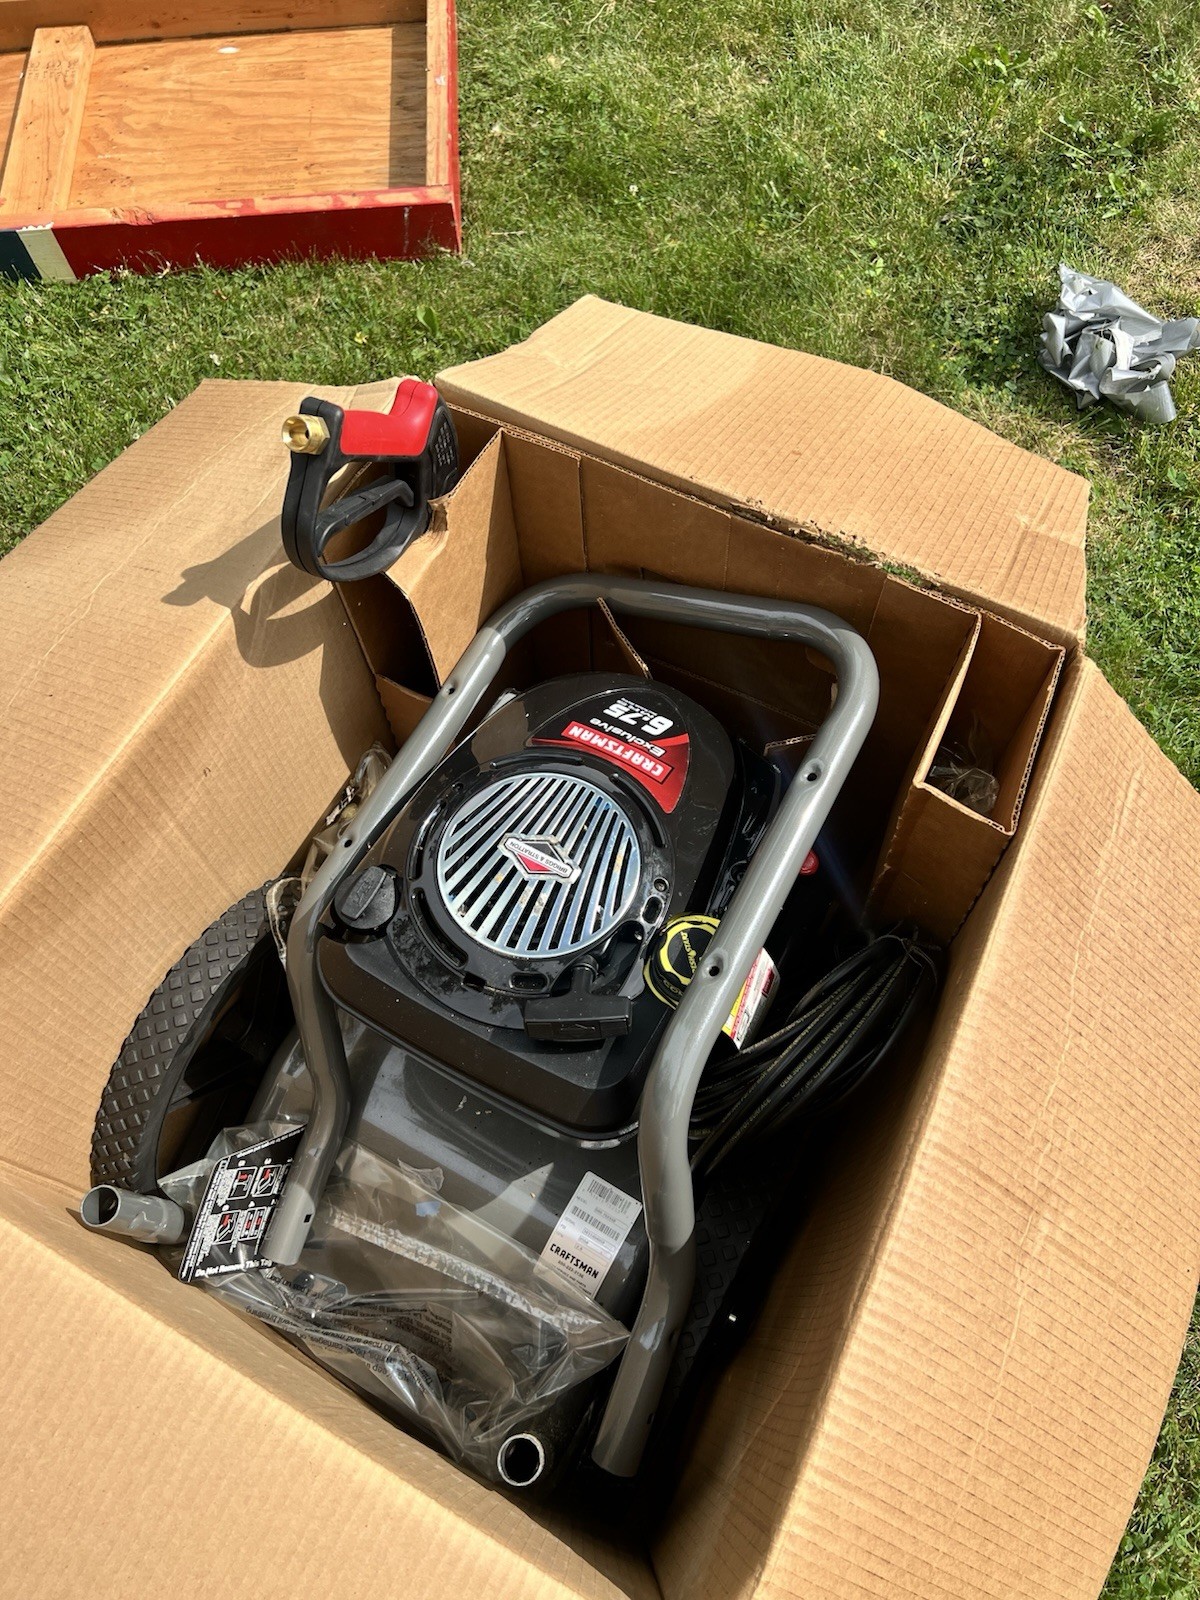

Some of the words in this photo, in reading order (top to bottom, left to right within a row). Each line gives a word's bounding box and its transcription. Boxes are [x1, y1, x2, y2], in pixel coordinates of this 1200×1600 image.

[603, 703, 674, 736] 6.75
[589, 717, 665, 757] Exclusive
[567, 725, 665, 777] CRAFTSMAN
[509, 841, 540, 859] STRATTON
[544, 858, 568, 874] BRIGGS
[779, 1073, 793, 1088] OEM
[207, 1265, 219, 1275] Not
[245, 1260, 260, 1269] This
[260, 1258, 273, 1268] Tag
[549, 1243, 600, 1279] CRAFTSMAN
